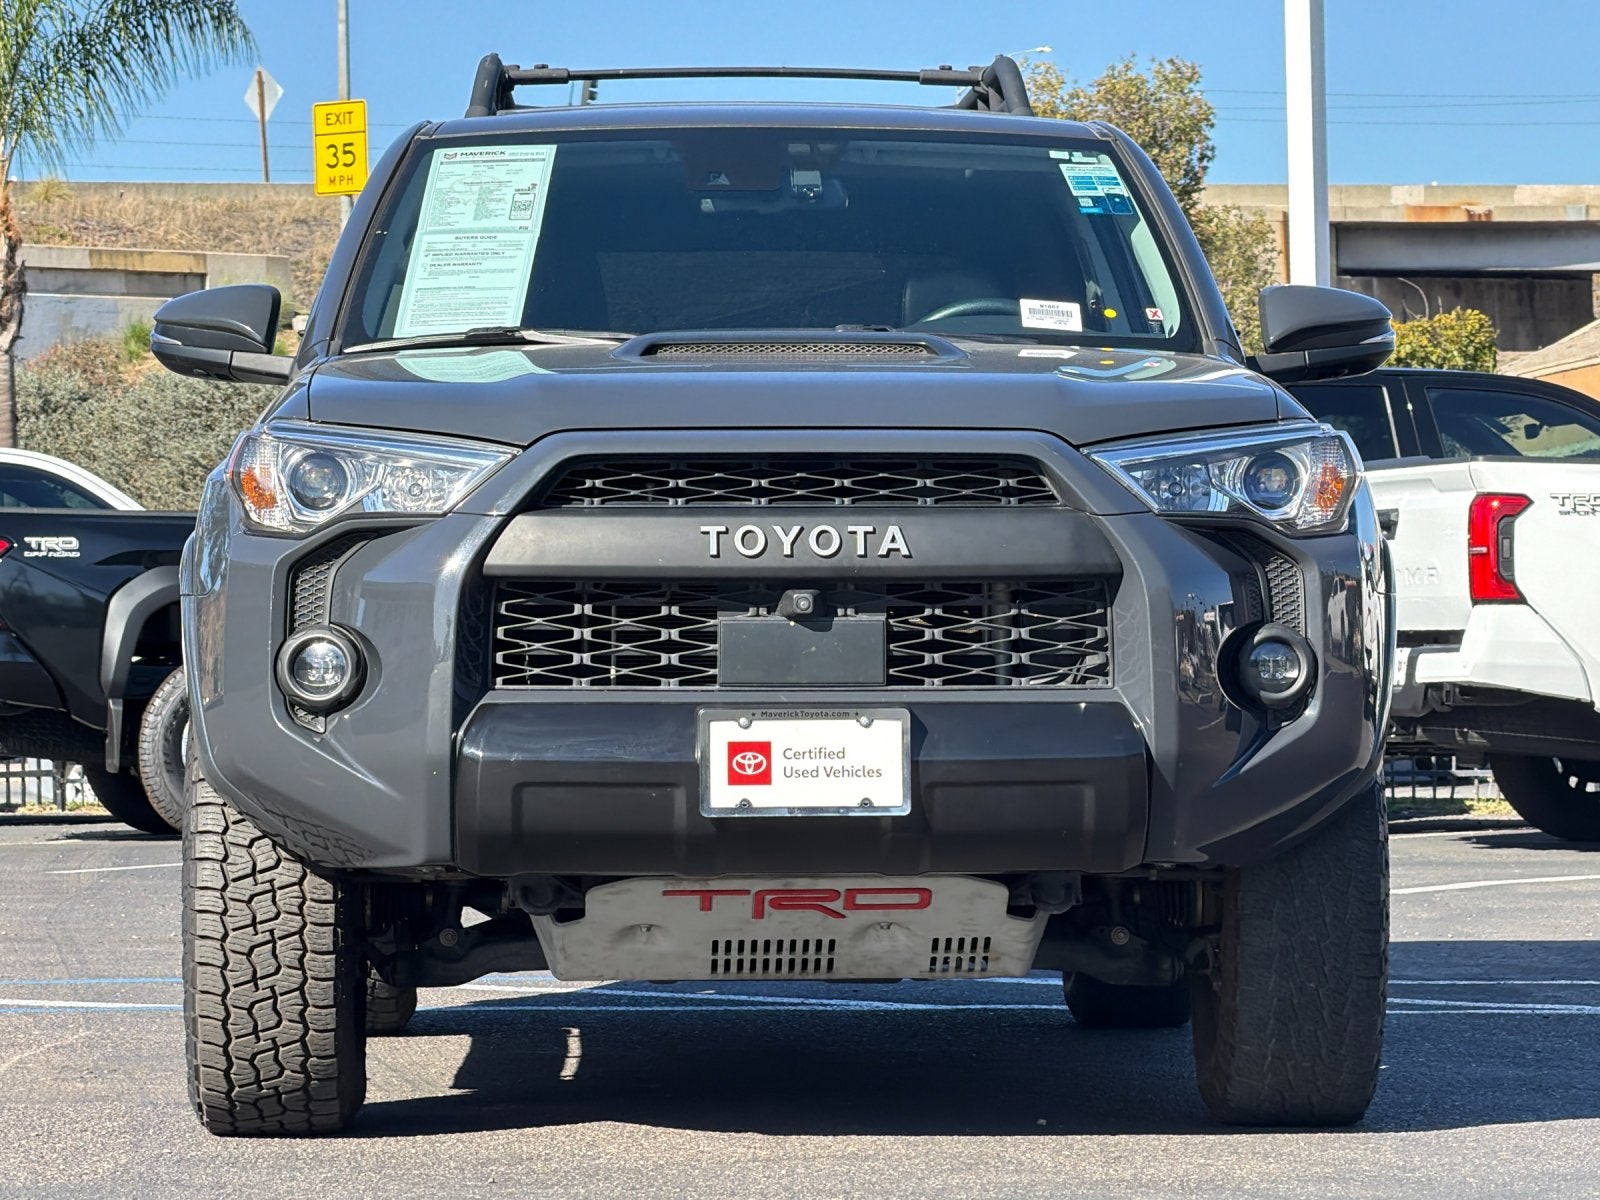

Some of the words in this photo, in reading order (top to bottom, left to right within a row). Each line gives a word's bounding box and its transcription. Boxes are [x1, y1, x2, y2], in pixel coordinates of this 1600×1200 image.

[325, 111, 354, 126] EXIT
[326, 142, 356, 169] 35
[328, 174, 354, 186] MPH
[23, 536, 80, 551] TRD
[700, 524, 913, 559] TOYOTA
[760, 710, 851, 719] MaverickToyota.com
[782, 747, 846, 760] Certified
[782, 766, 819, 779] Used
[825, 765, 882, 778] Vehicles
[662, 886, 933, 920] TRD
